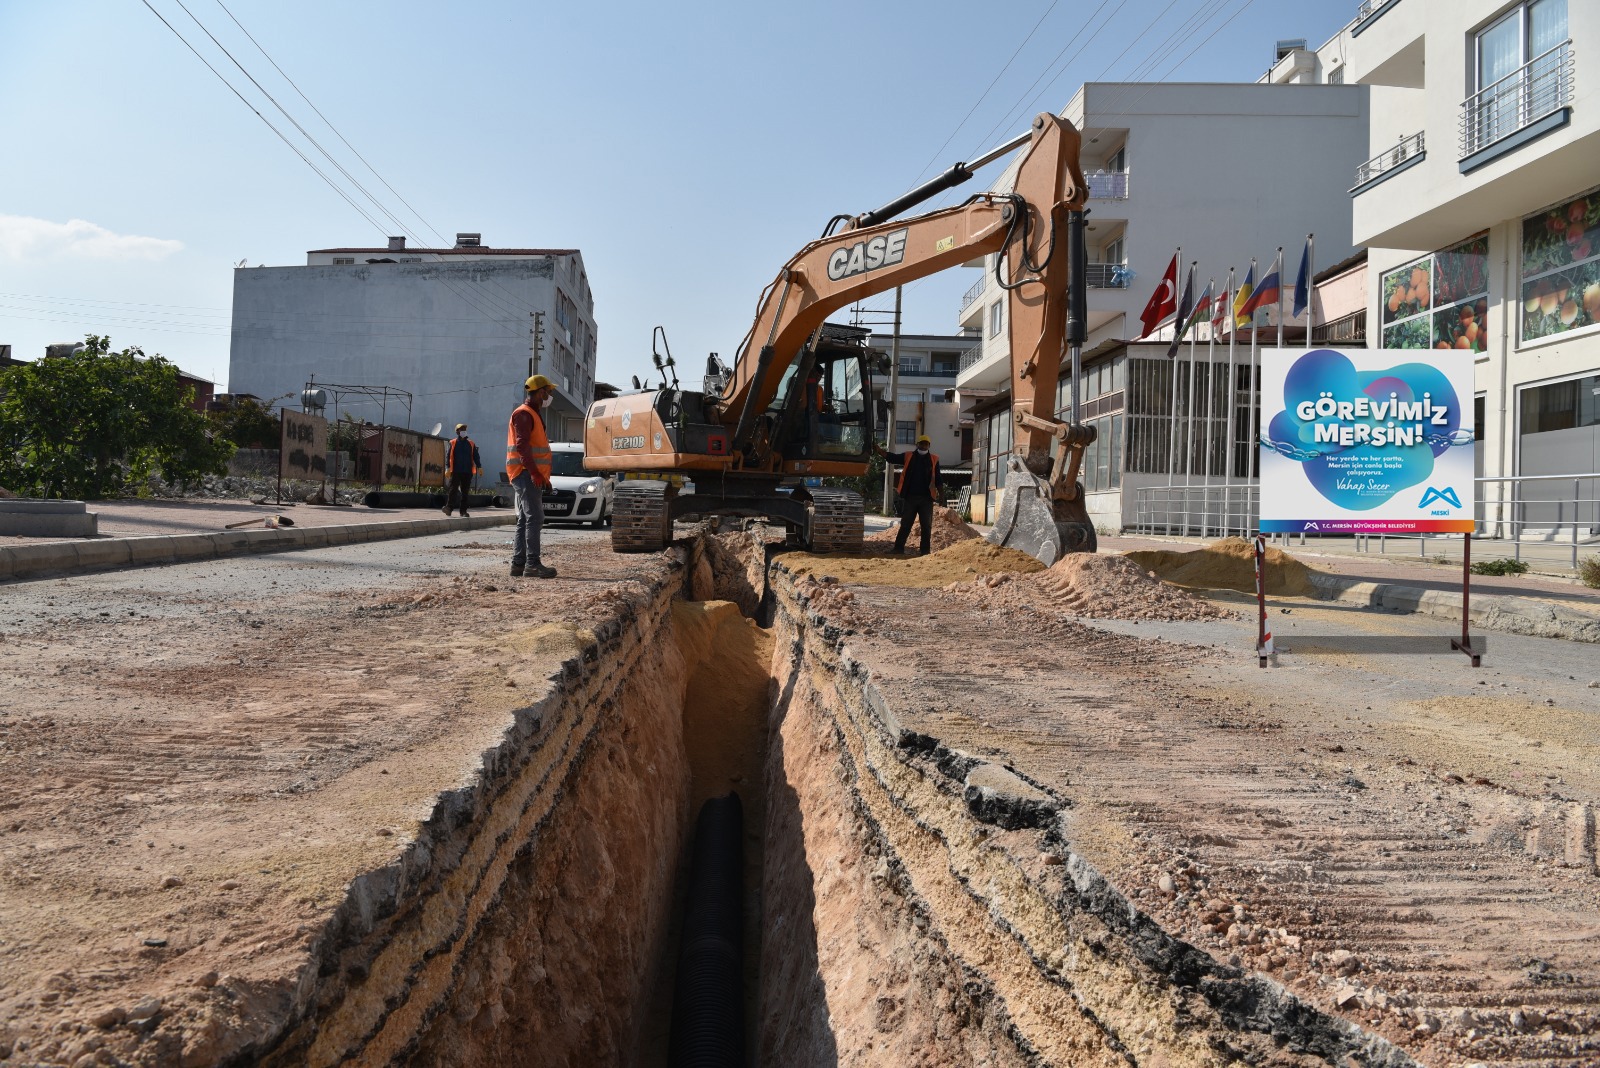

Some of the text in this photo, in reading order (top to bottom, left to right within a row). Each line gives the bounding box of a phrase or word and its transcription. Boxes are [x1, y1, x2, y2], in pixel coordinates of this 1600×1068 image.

[827, 227, 909, 281] CASE
[1296, 392, 1448, 425] GÖREVİMİZ
[612, 436, 645, 450] CX210B
[1314, 422, 1423, 447] MERSİN!
[1336, 478, 1365, 495] Vahap
[1354, 522, 1386, 530] BÜYÜKŞEHİR
